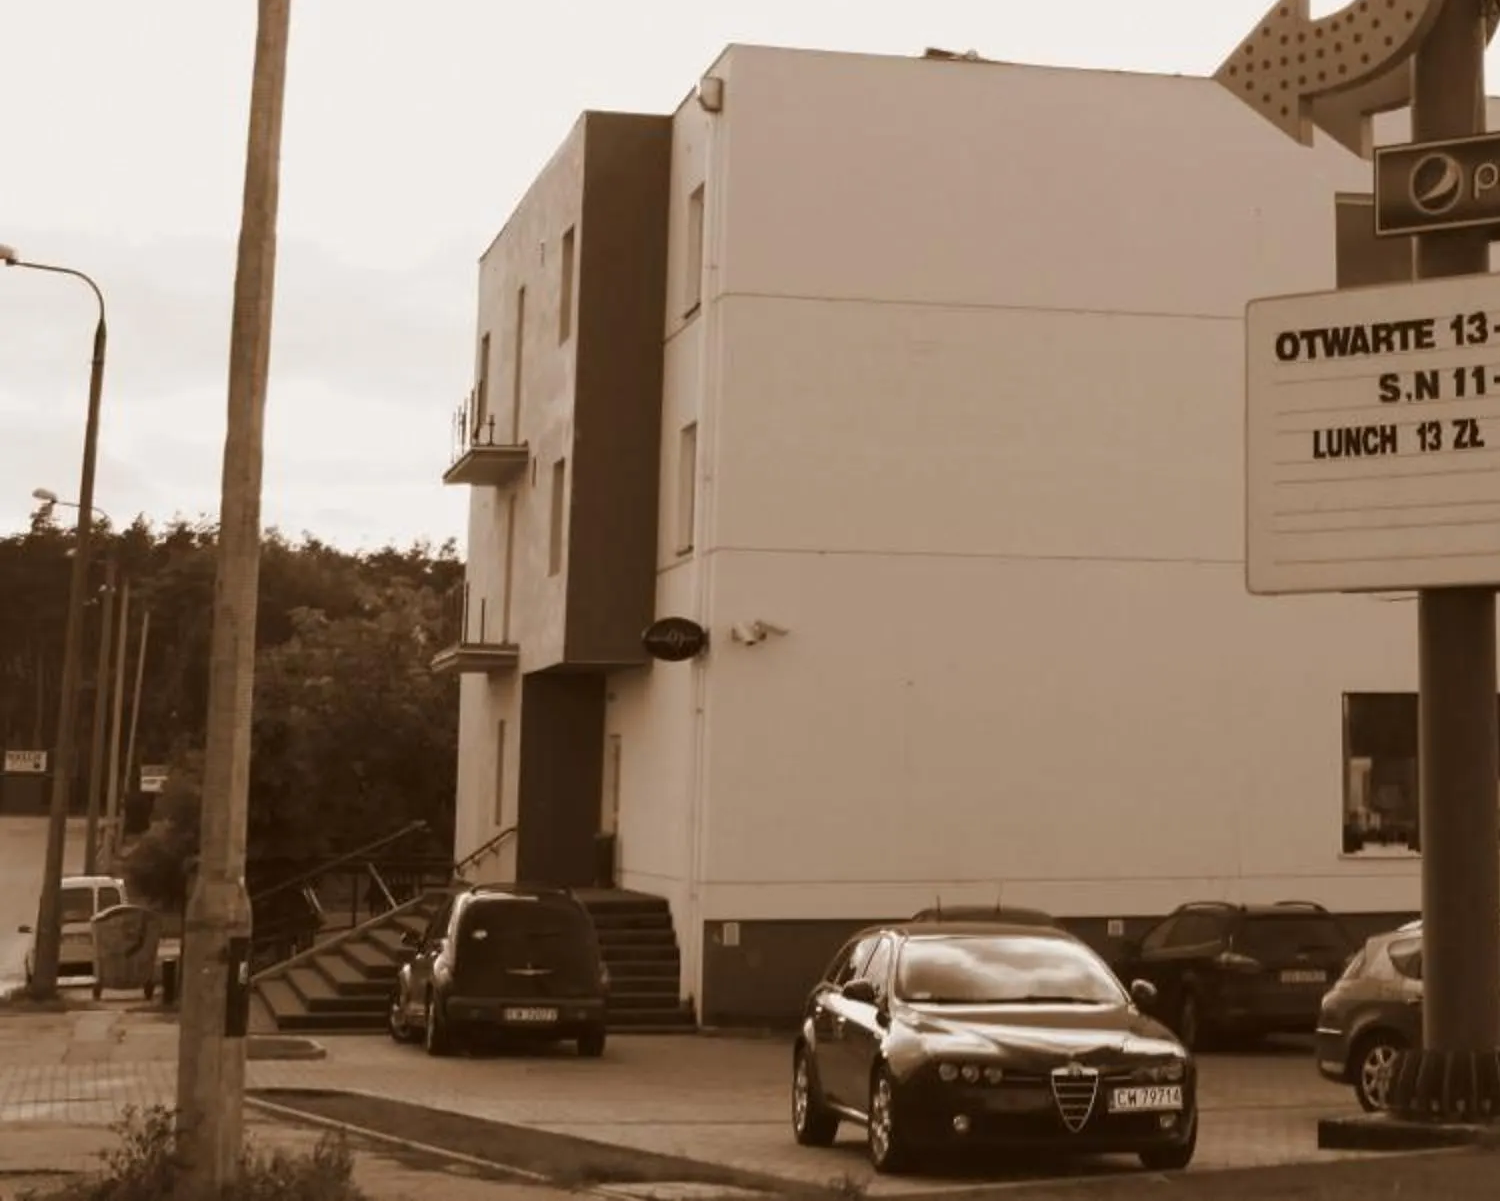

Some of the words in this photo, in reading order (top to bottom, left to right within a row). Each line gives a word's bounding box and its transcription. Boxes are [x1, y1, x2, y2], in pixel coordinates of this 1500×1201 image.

[1275, 318, 1436, 361] OTWARTE
[1313, 424, 1398, 459] LUNCH
[1417, 421, 1442, 452] 13
[1452, 418, 1485, 449] ZŁ
[1118, 1090, 1137, 1105] CW
